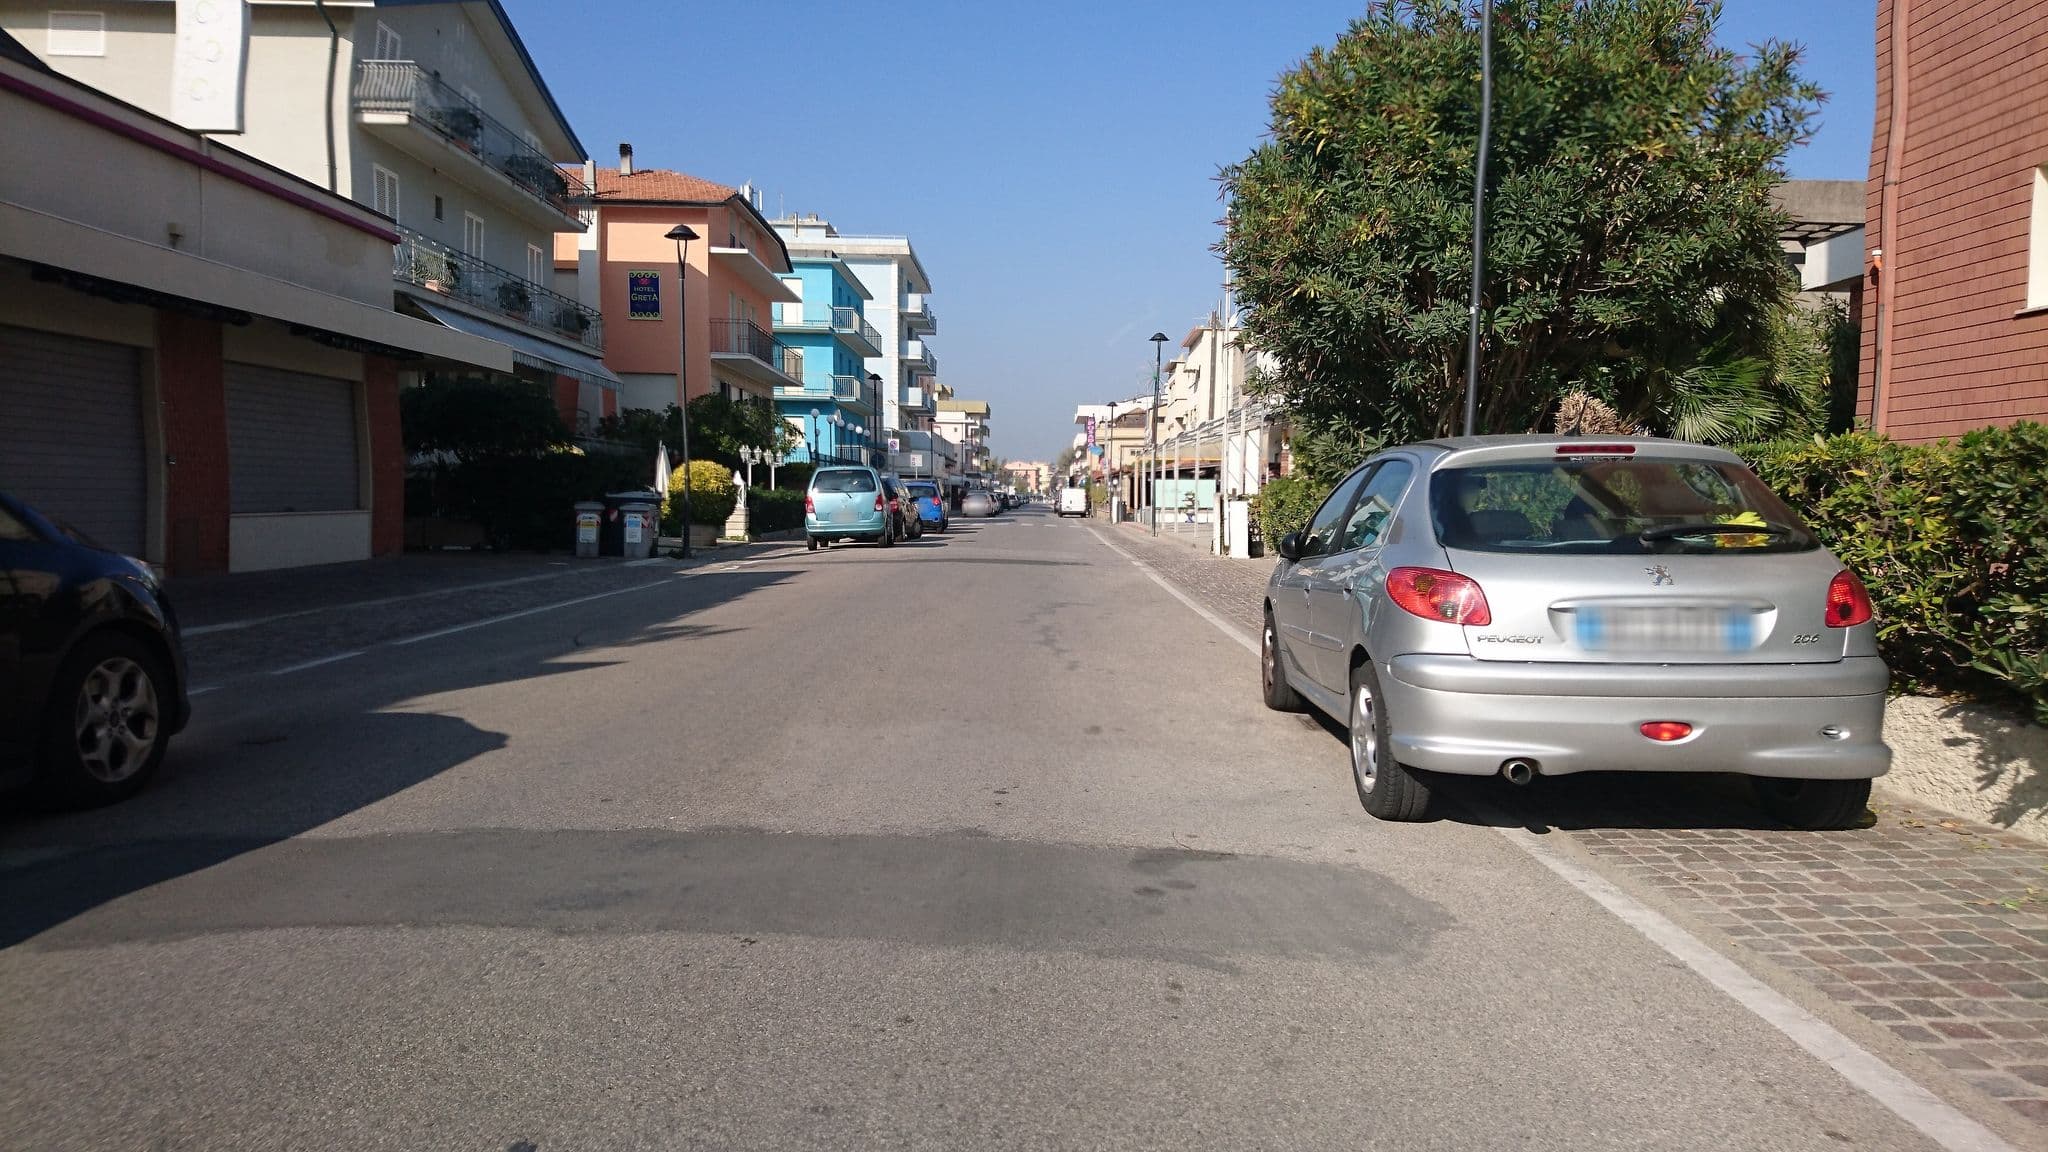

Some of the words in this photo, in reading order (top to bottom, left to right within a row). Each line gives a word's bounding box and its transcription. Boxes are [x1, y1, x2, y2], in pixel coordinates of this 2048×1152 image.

[631, 293, 659, 301] GRETA
[1477, 634, 1544, 644] PEUGEOT
[1792, 633, 1821, 644] 206
